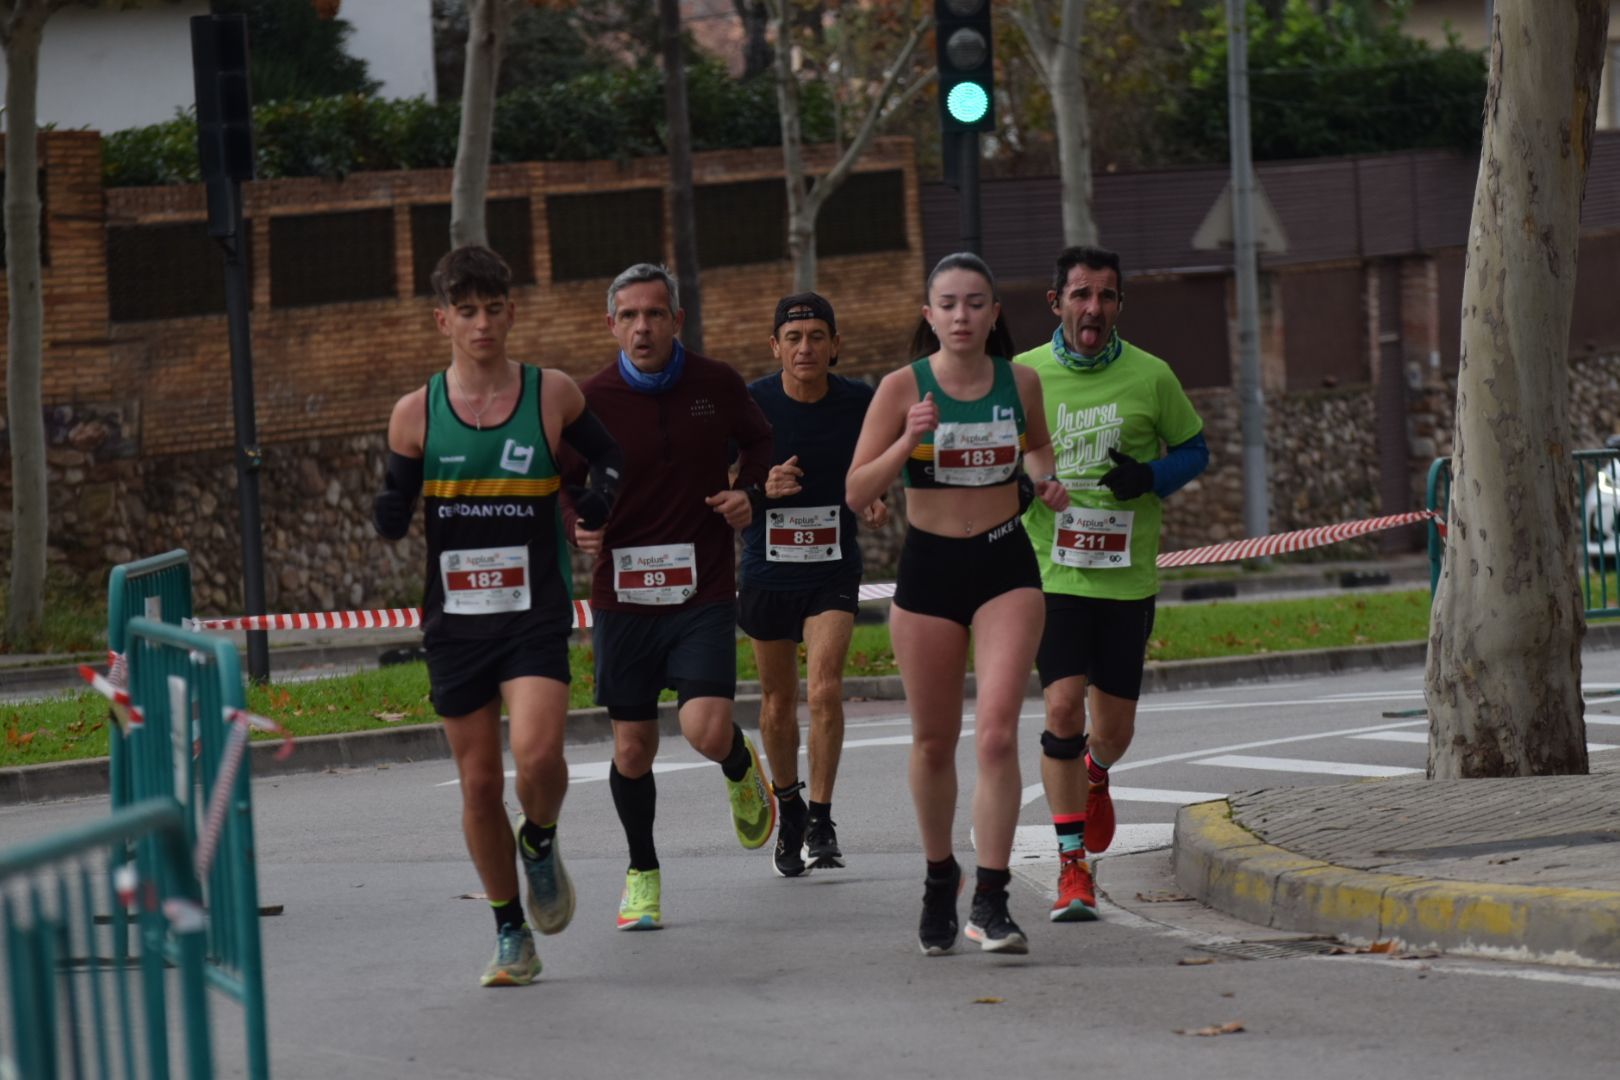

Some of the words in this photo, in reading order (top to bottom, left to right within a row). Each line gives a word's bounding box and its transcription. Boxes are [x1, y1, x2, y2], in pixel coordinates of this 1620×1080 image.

[1076, 403, 1122, 429] cursa
[961, 450, 995, 466] 183
[438, 503, 535, 518] CERDANYOLA
[793, 531, 815, 544] 83
[988, 520, 1014, 543] NIKE
[1073, 533, 1106, 549] 211
[467, 571, 503, 588] 182
[643, 571, 666, 587] 89
